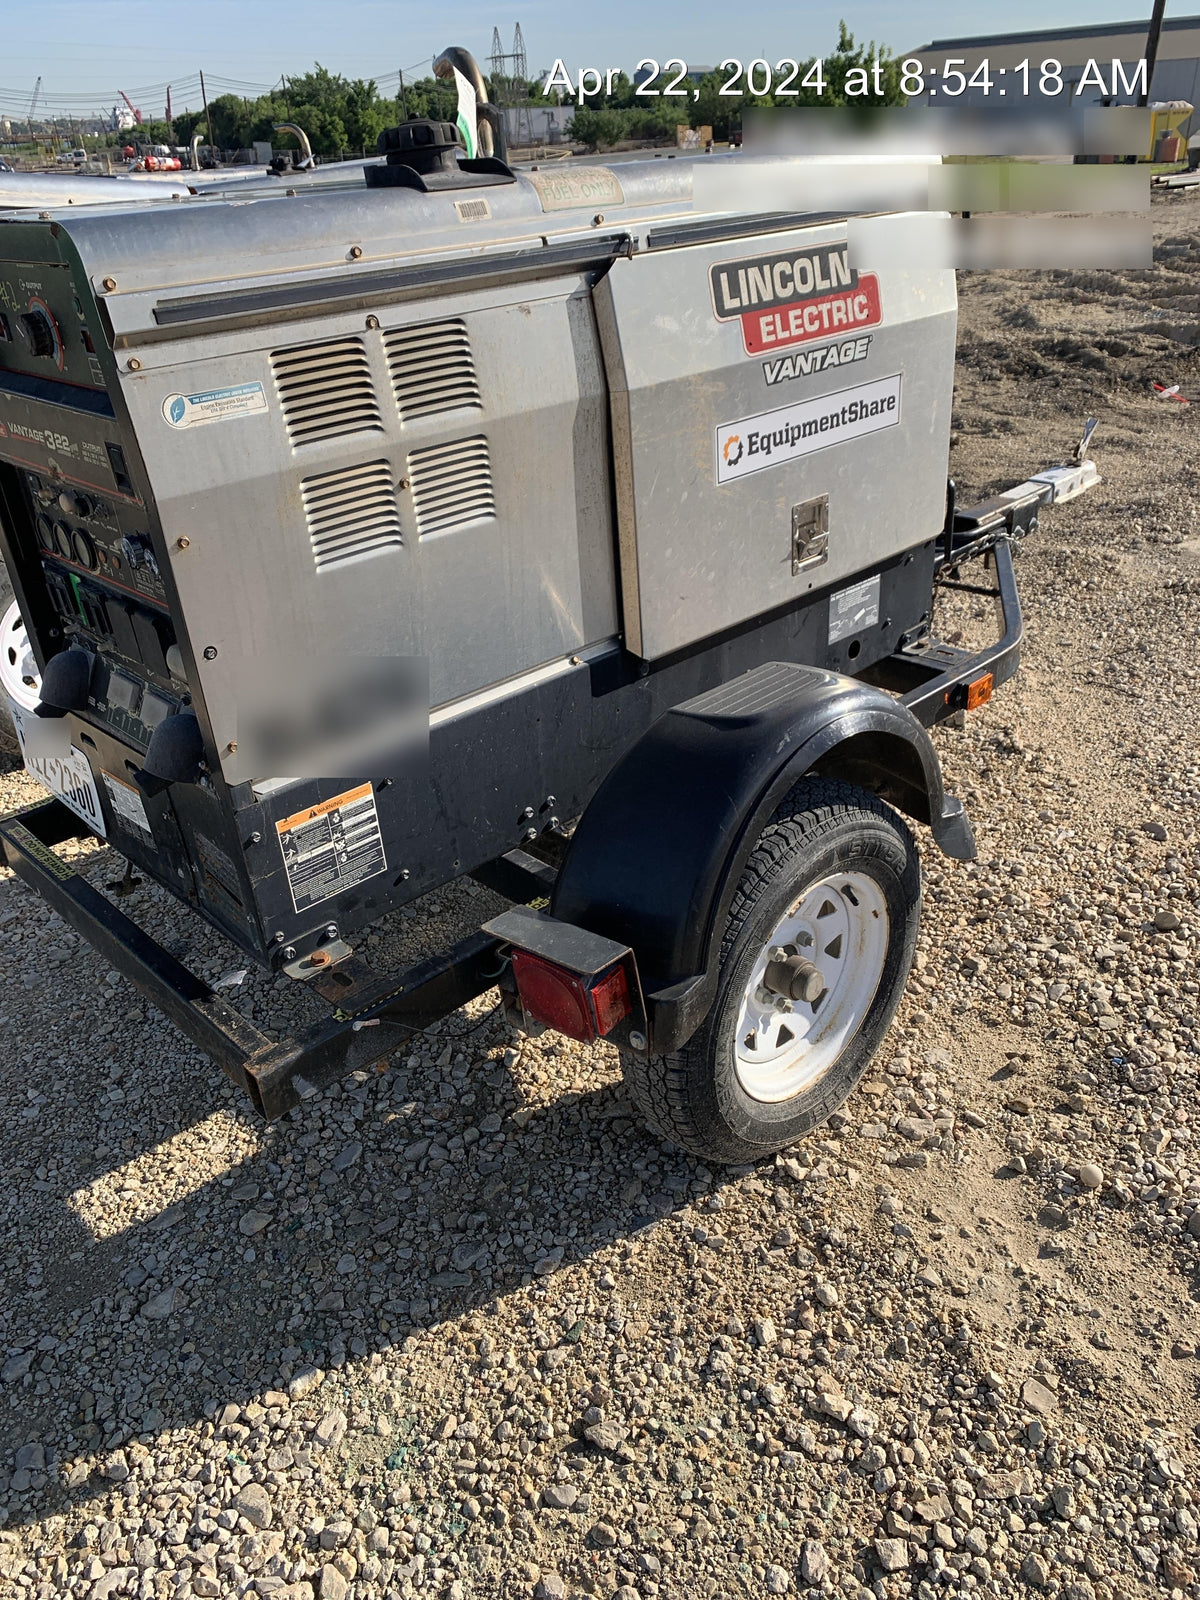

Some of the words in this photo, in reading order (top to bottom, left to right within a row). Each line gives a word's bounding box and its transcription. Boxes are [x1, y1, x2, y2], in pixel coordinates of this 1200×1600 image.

[542, 185, 579, 201] FUEL
[580, 181, 615, 198] ONLY
[720, 250, 852, 310] LINCOLN
[759, 294, 869, 343] ELECTRIC
[763, 335, 872, 386] VANTAGE
[7, 421, 45, 443] VANTAGE
[44, 429, 71, 451] 322
[747, 395, 896, 456] EquipmentShare
[316, 799, 343, 814] WARNING
